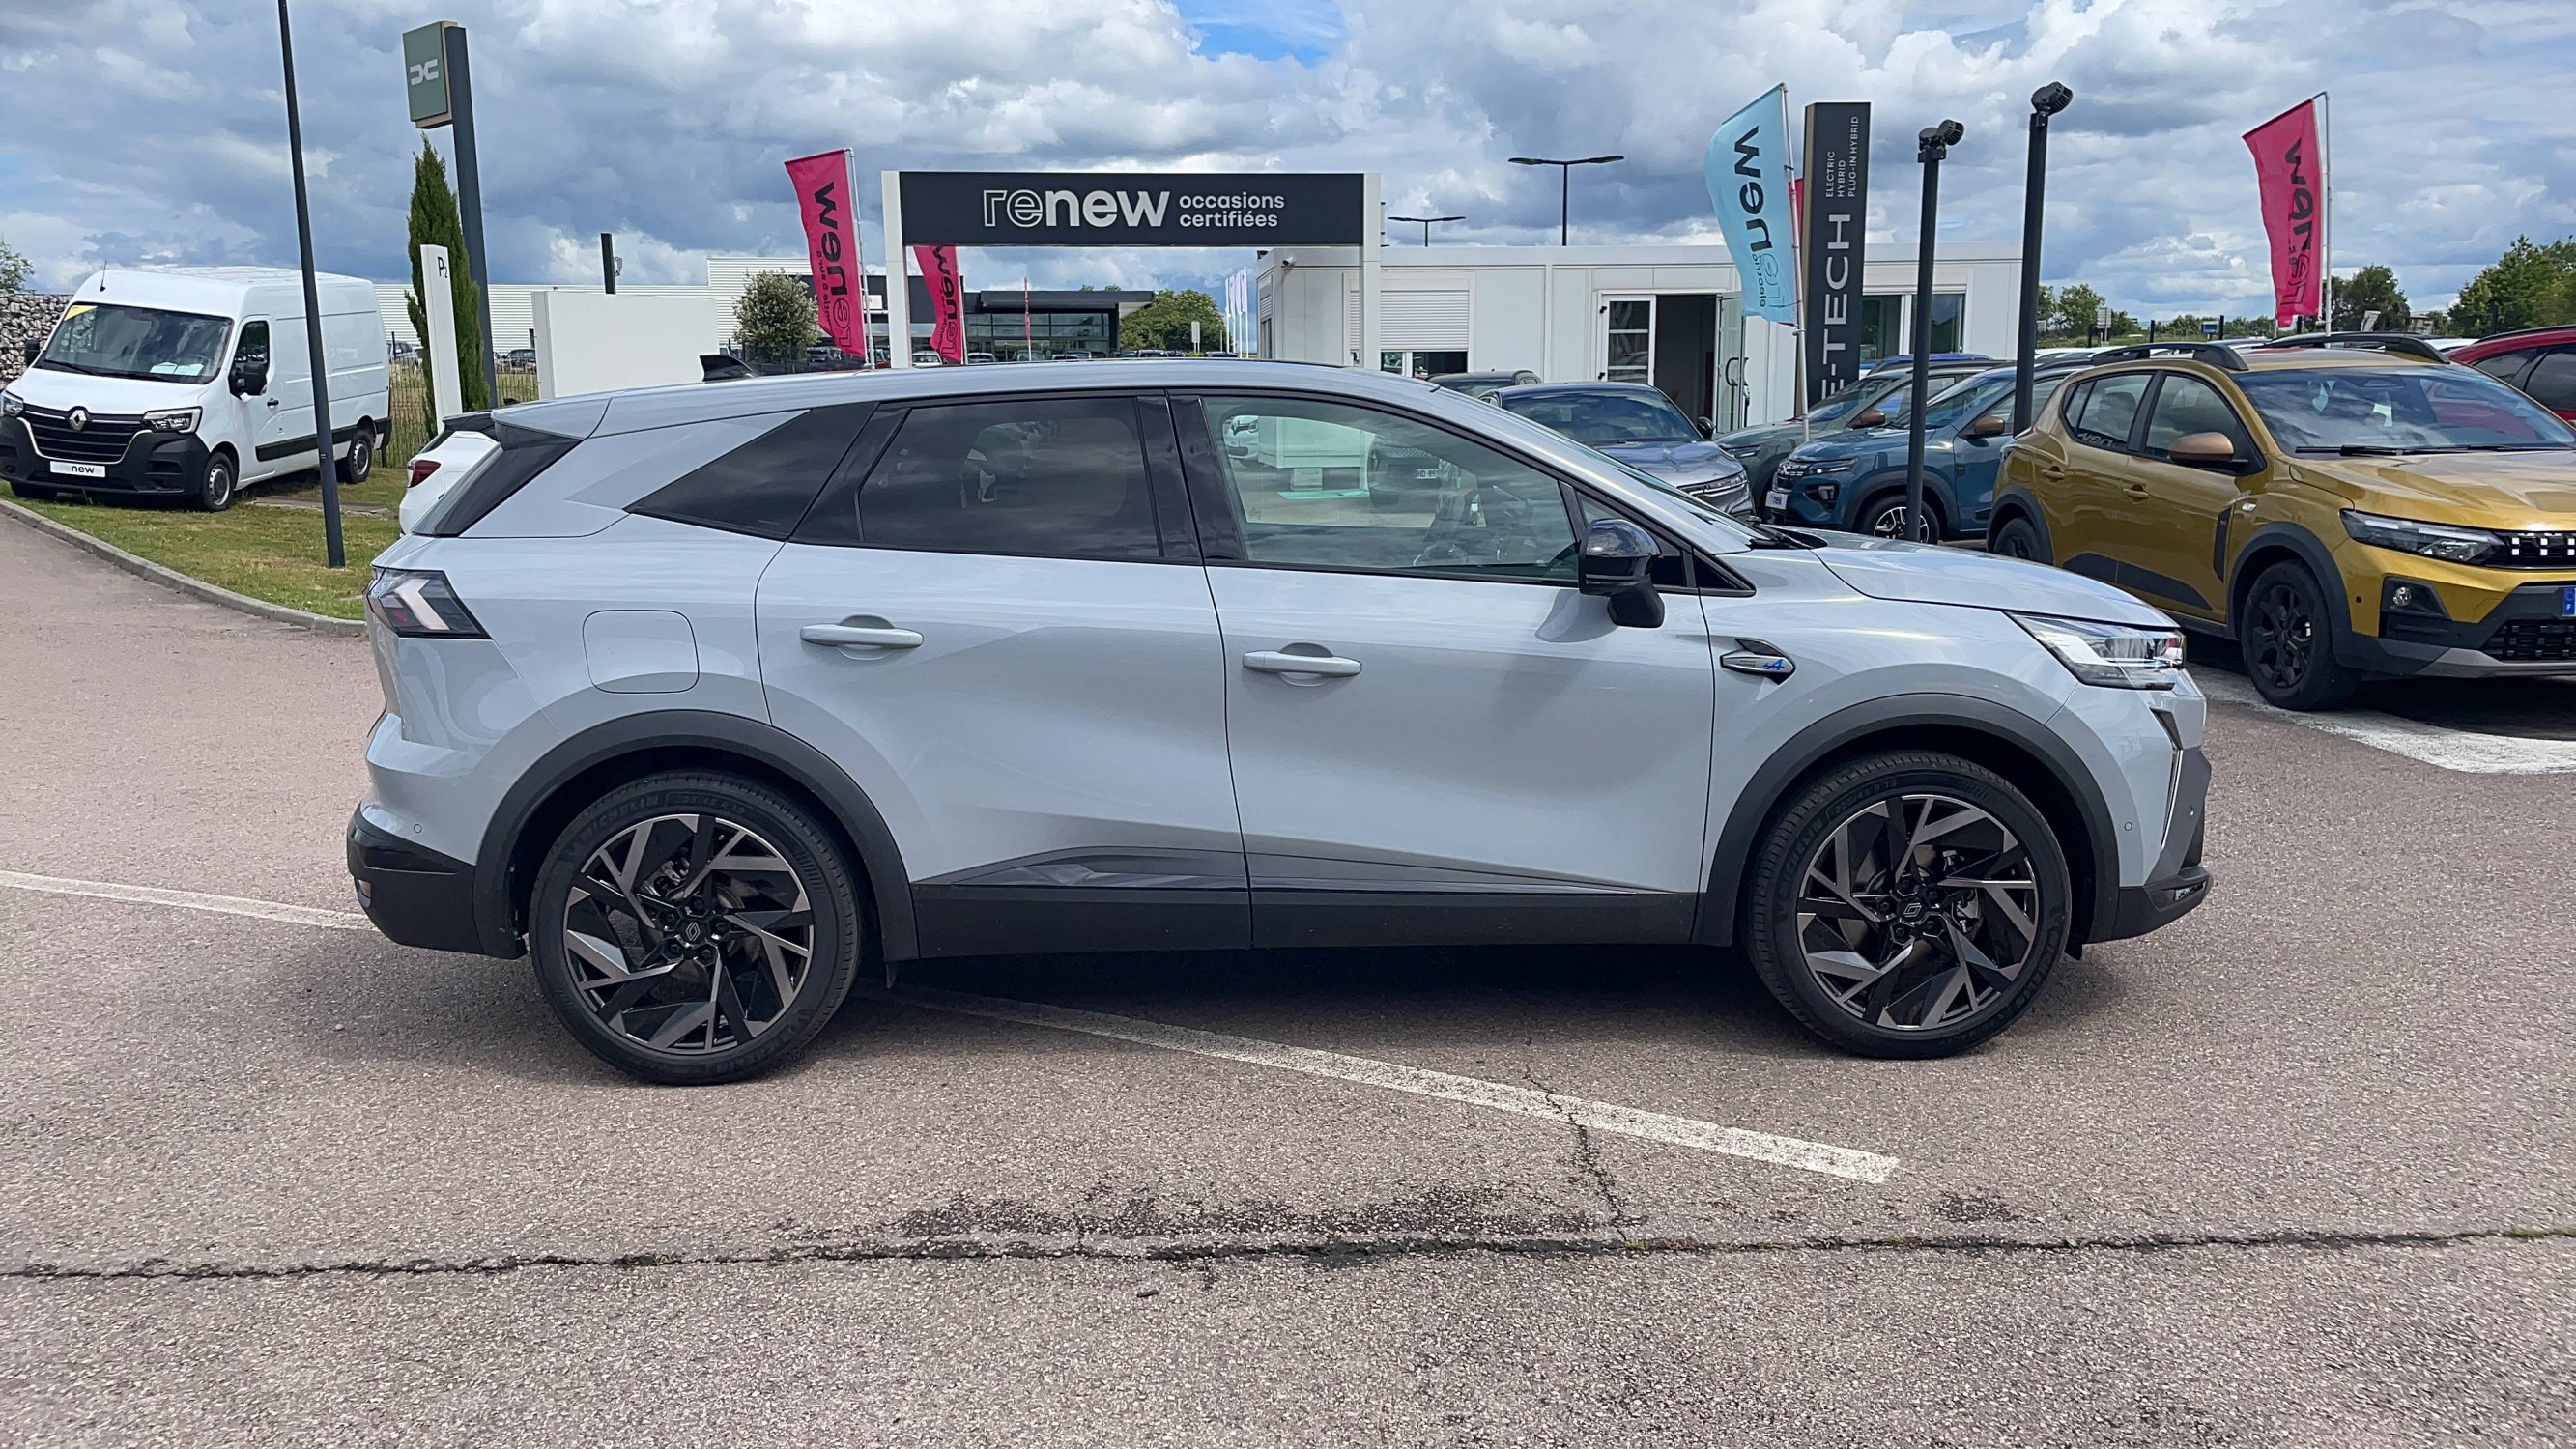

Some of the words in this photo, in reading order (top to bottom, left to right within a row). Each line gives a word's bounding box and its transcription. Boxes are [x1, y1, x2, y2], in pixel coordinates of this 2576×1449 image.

[1849, 116, 1859, 154] HYBRID
[1825, 151, 1836, 198] ELECTRIC
[1837, 159, 1846, 198] HYBRID
[1847, 156, 1857, 198] PLUG-IN
[983, 189, 1171, 227] renew
[1179, 191, 1285, 209] occasions
[1179, 211, 1278, 228] certifiées
[1821, 214, 1851, 401] E-TECH
